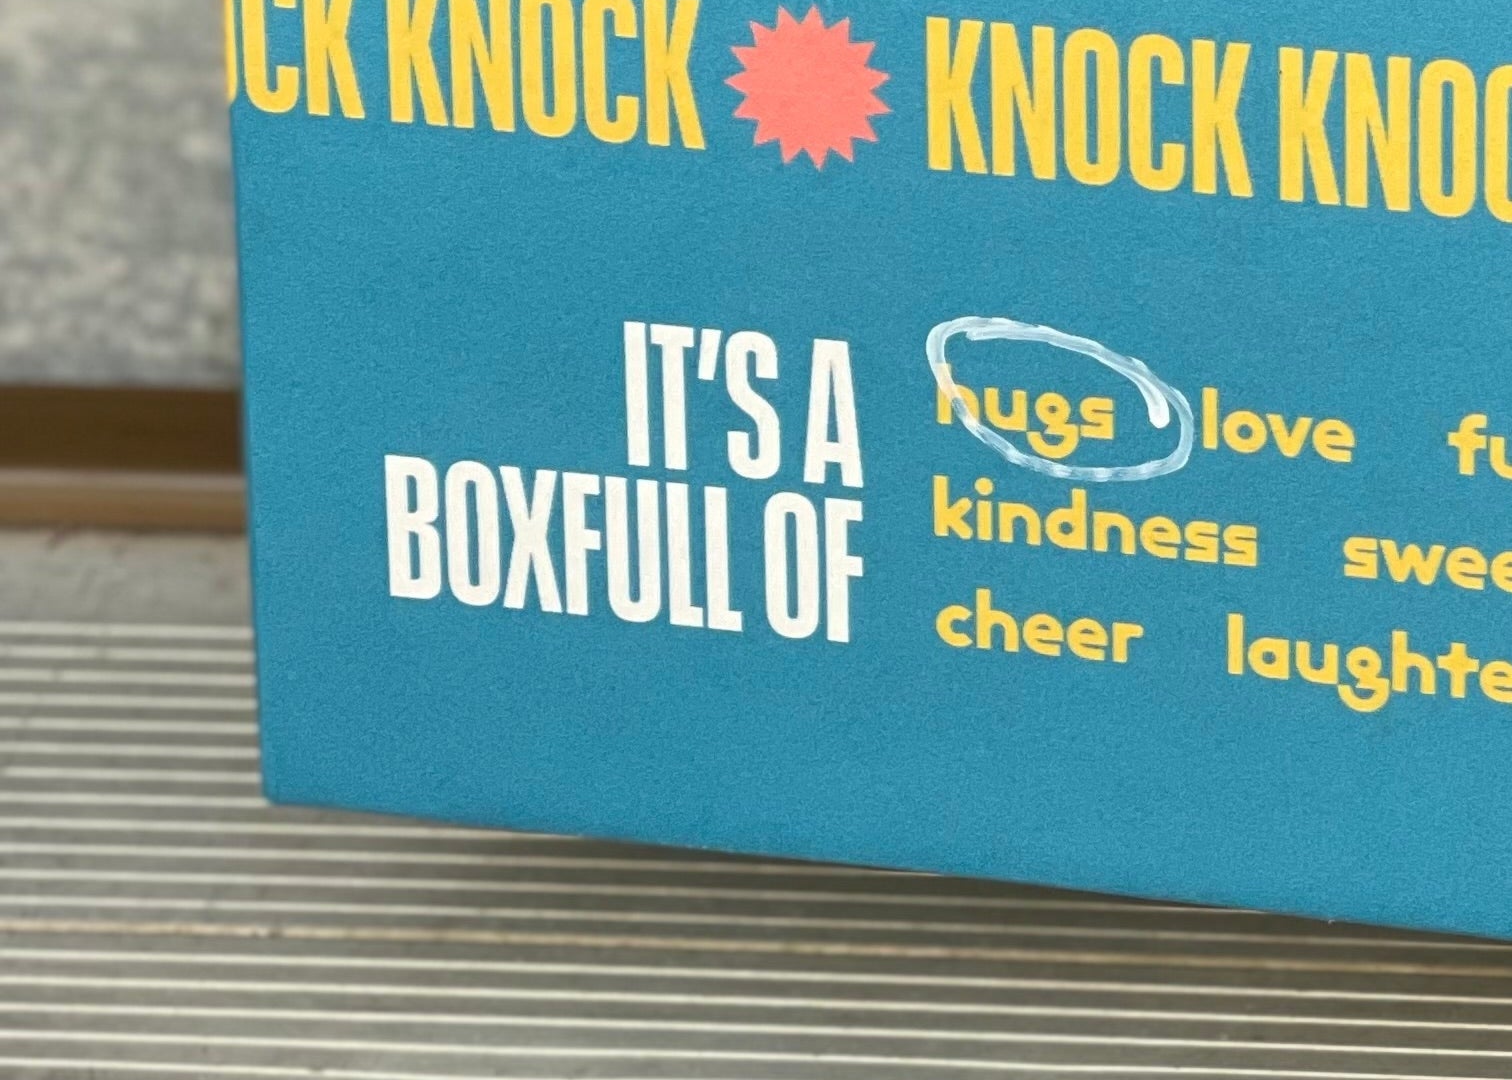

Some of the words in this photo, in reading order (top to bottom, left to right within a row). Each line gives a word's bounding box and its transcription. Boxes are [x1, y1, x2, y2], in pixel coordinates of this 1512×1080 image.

[926, 16, 1253, 198] KNOCK
[623, 321, 780, 480] IT'S
[803, 338, 864, 488] A
[935, 362, 1114, 459] hugs
[1202, 387, 1356, 463] love
[385, 454, 744, 632] BOXFULL
[764, 491, 864, 643] OF
[932, 475, 1258, 567] kindness
[935, 588, 1144, 664] cheer
